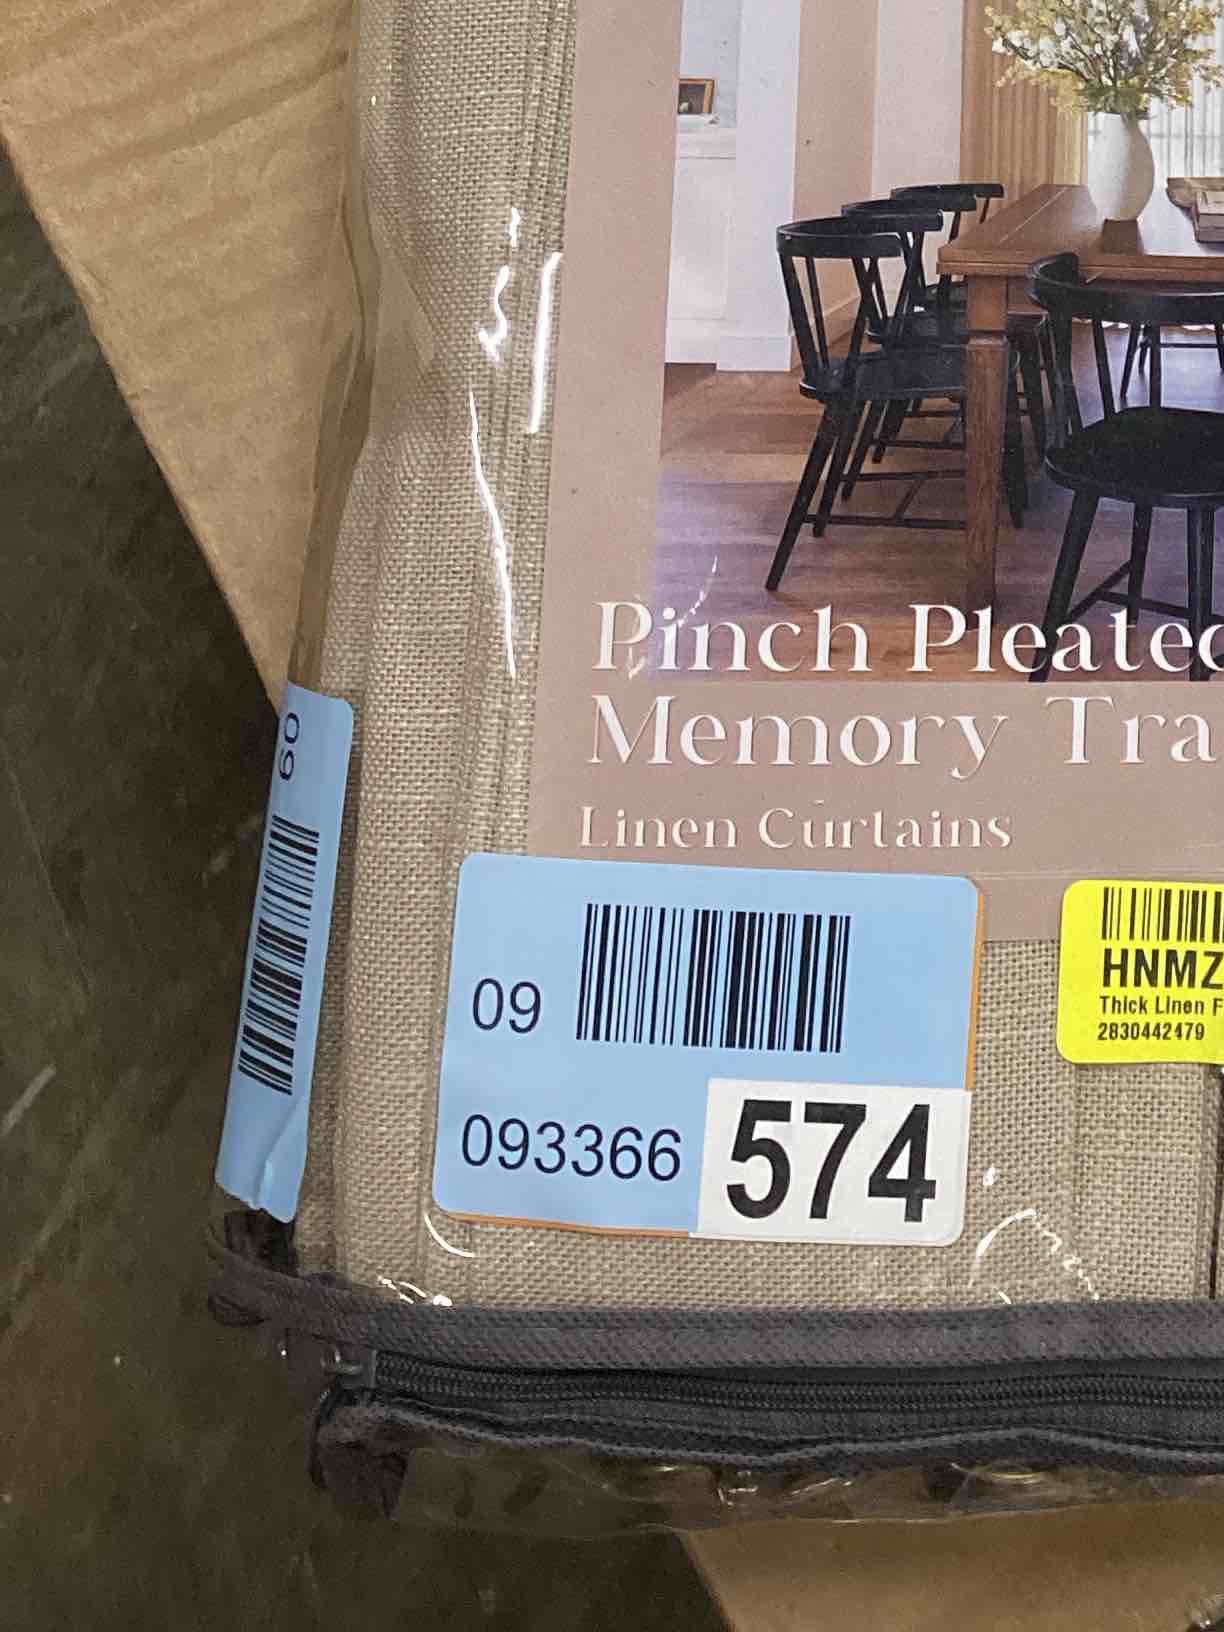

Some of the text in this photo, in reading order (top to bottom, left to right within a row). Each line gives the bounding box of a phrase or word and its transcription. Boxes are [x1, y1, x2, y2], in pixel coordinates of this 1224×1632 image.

[592, 600, 873, 674] Pinch
[586, 694, 1008, 780] Memory
[579, 805, 1013, 850] Linen Curtains
[472, 977, 542, 1034] 09
[1096, 1021, 1206, 1041] 2830442479
[1099, 995, 1149, 1016] Thick
[1154, 995, 1205, 1016] Linen
[461, 1113, 683, 1182] 093366
[726, 1098, 937, 1223] 574
